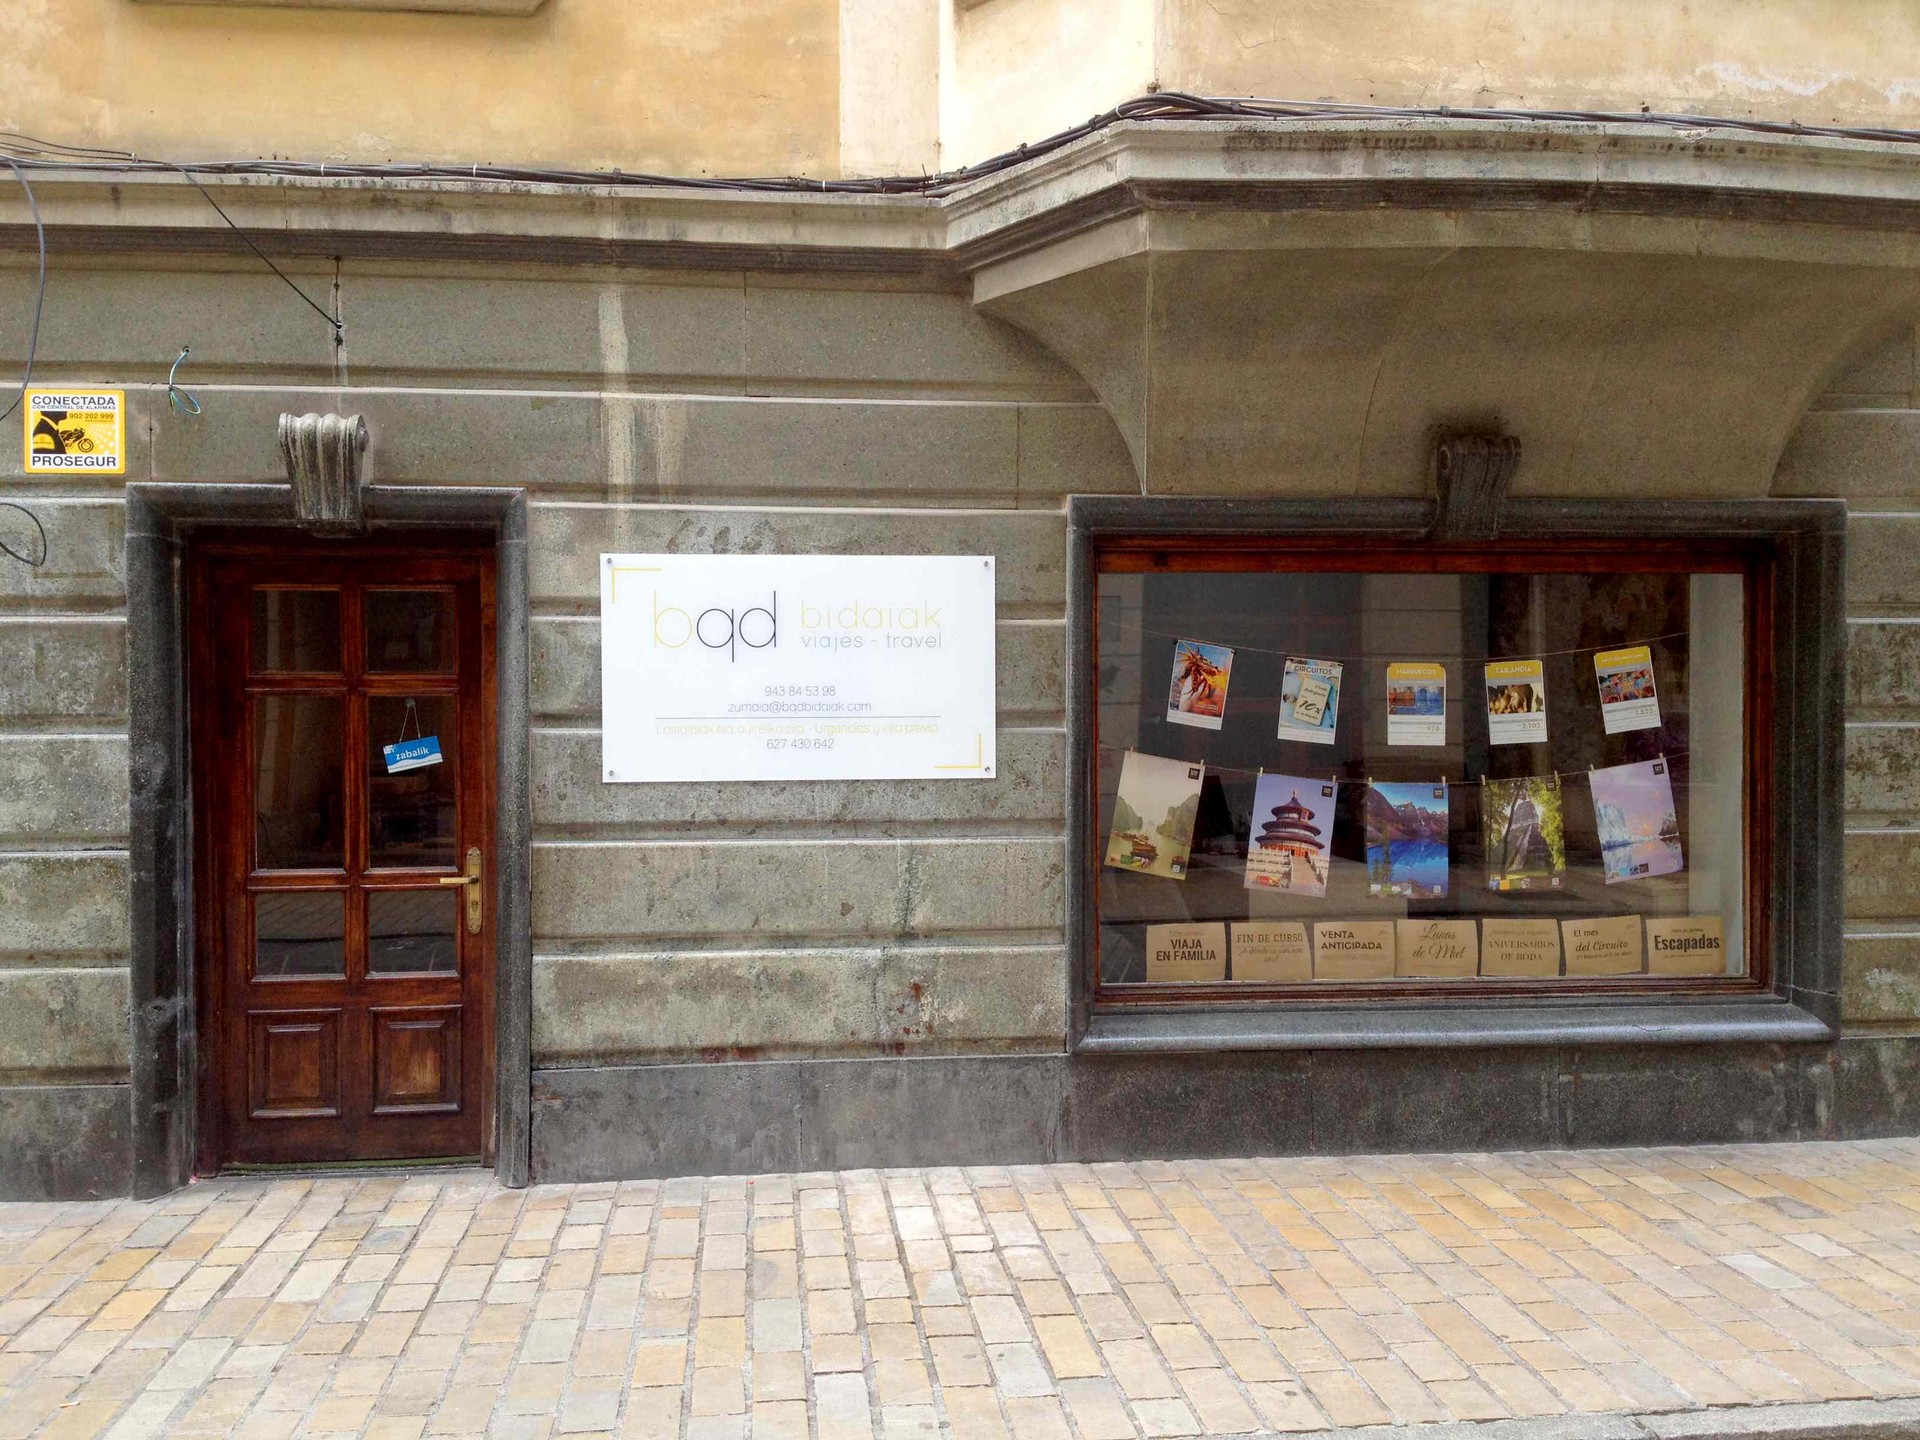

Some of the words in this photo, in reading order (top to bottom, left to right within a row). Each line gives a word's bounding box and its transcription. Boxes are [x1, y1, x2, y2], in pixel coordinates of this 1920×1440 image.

[32, 396, 116, 406] CONECTADA
[32, 456, 116, 467] PROSEGUR
[801, 600, 942, 629] bidaiak
[654, 590, 776, 663] bqd
[801, 632, 863, 652] viajes
[887, 632, 942, 648] travel
[1294, 665, 1333, 675] CIRCUITOS
[764, 685, 785, 697] 943
[788, 685, 802, 697] 84
[805, 685, 819, 697] 53
[822, 685, 836, 697] 98
[766, 739, 788, 750] 627
[791, 738, 811, 750] 430
[814, 738, 835, 750] 642
[396, 747, 429, 760] zabalik
[1237, 934, 1254, 943] FIN
[1258, 934, 1270, 943] DE
[1274, 933, 1303, 942] CURSO
[1321, 931, 1355, 939] VENTA
[1171, 939, 1202, 949] VIAJA
[1321, 942, 1383, 950] ANTICIPADA
[1576, 941, 1590, 952] del
[1593, 940, 1629, 951] Circuito
[1654, 934, 1720, 952] Escapadas
[1157, 951, 1170, 961] EN
[1174, 950, 1216, 960] FAMILIA
[1413, 946, 1426, 957] de
